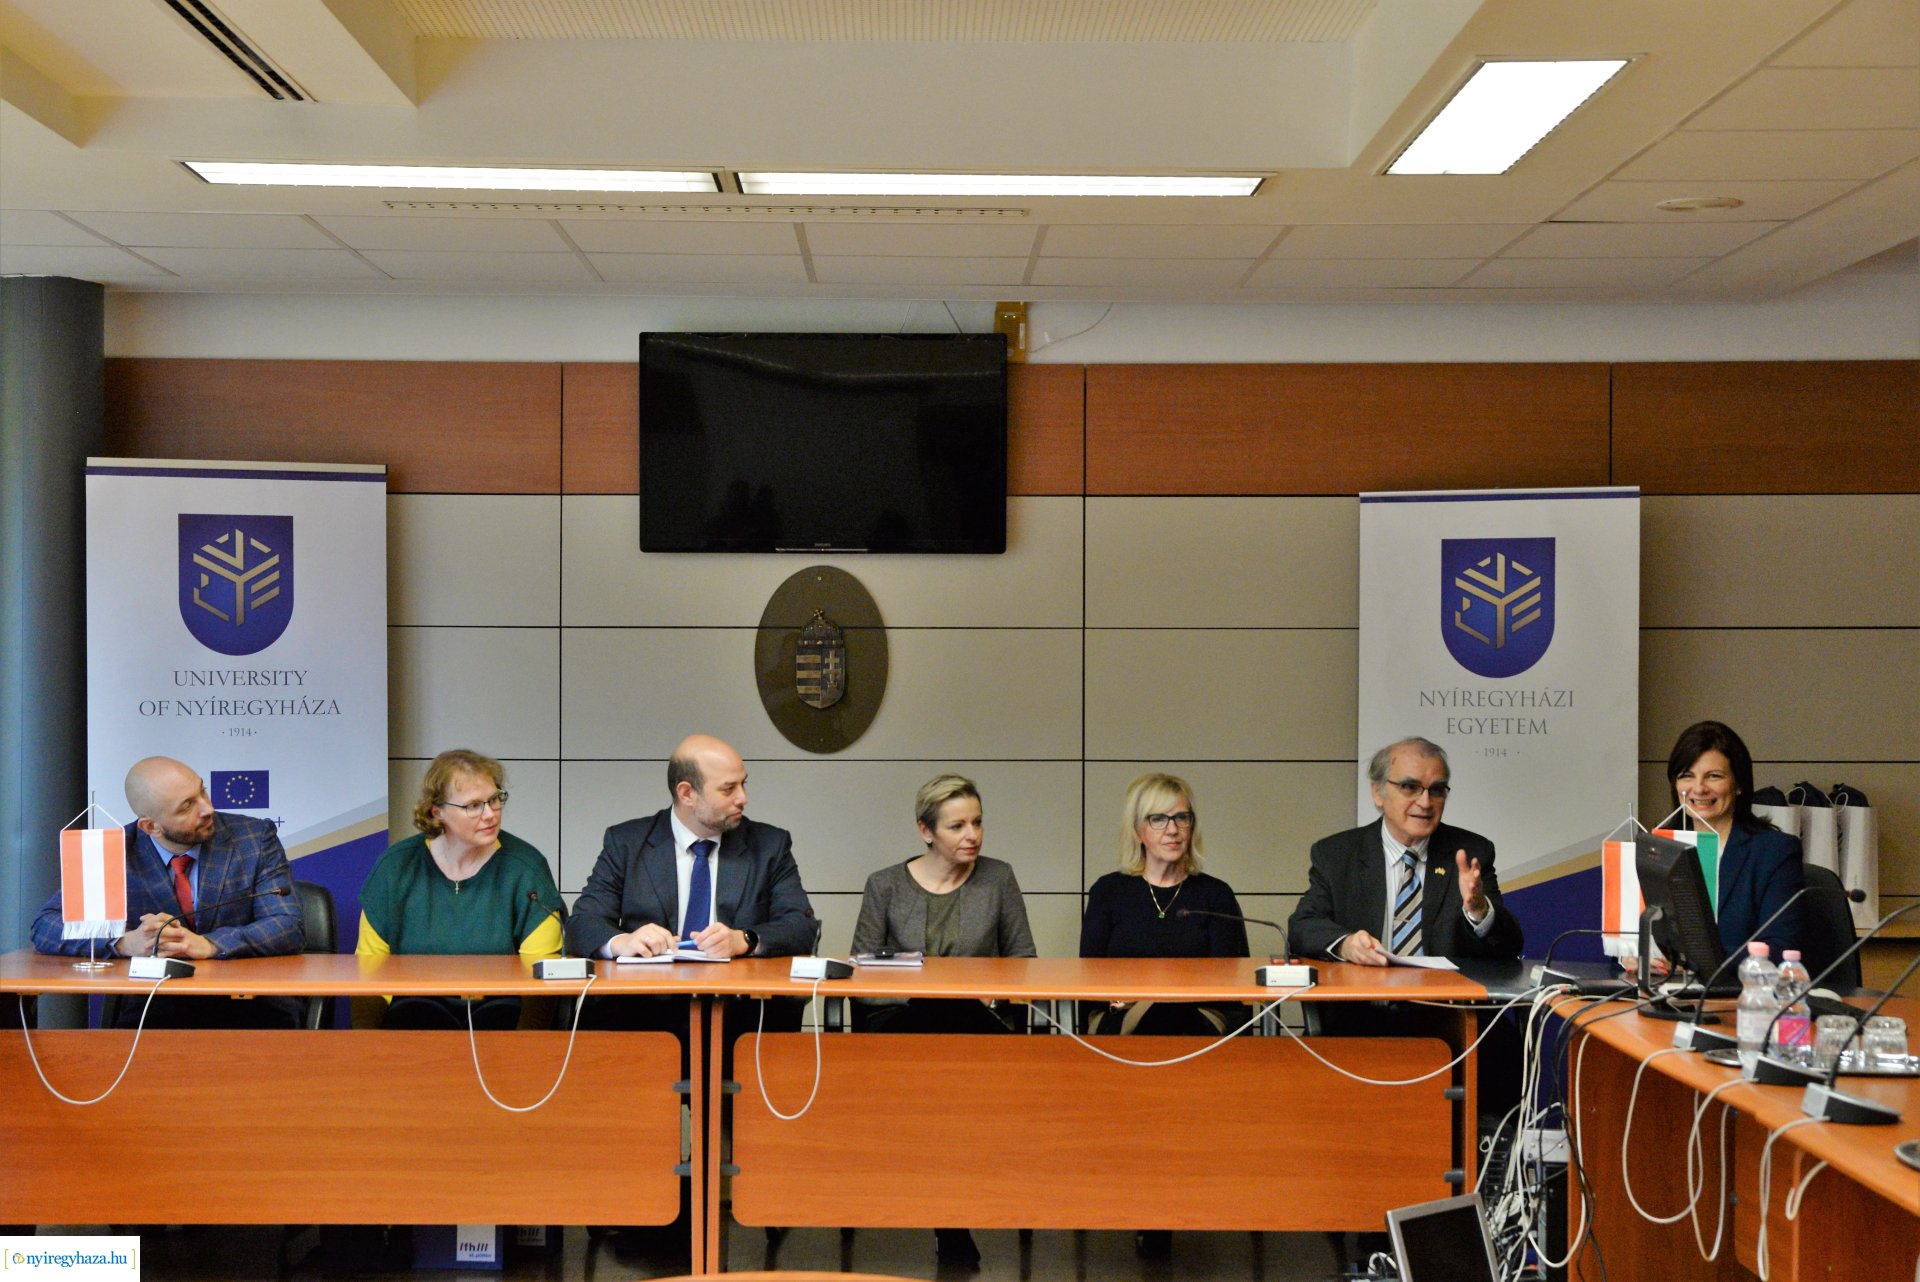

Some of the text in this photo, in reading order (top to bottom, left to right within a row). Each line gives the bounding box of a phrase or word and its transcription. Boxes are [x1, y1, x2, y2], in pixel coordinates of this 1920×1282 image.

[173, 670, 308, 687] UNIVERSITY
[138, 695, 342, 717] OF NYÍREGYHÁZA
[1420, 687, 1574, 708] NYÍREGYHÁZI
[229, 727, 252, 737] 1914
[1447, 717, 1548, 735] EGYETEM
[1484, 747, 1508, 757] 1914
